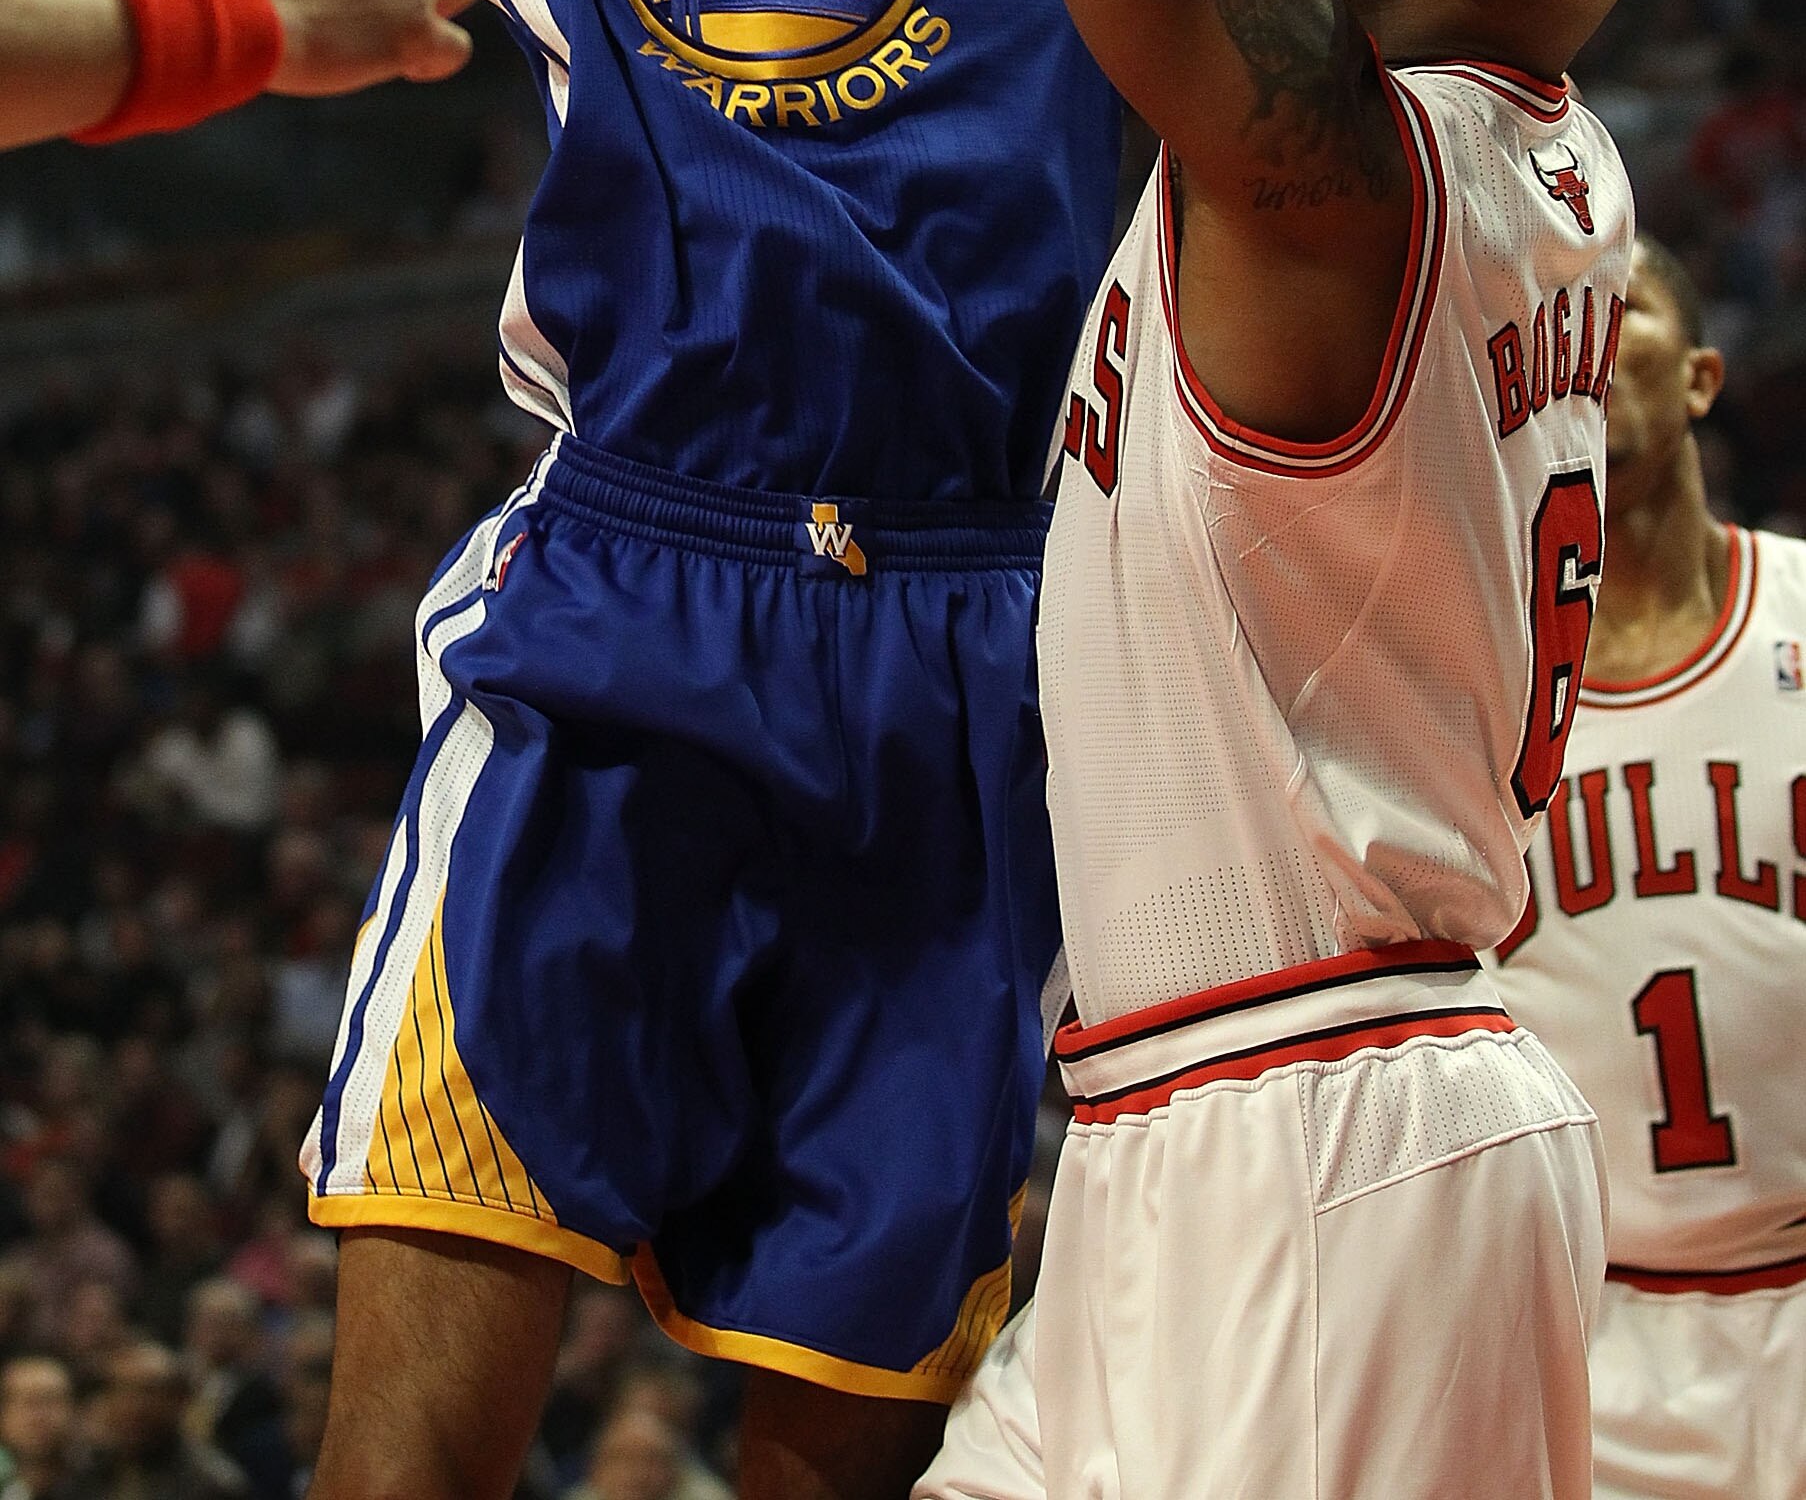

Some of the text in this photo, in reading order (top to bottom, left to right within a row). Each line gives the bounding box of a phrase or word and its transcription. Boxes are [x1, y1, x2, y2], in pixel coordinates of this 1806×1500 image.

[637, 6, 952, 128] WARRIORS
[805, 522, 853, 556] W
[1511, 470, 1603, 820] 6
[1496, 759, 1806, 965] ULL
[1630, 967, 1736, 1173] 1
